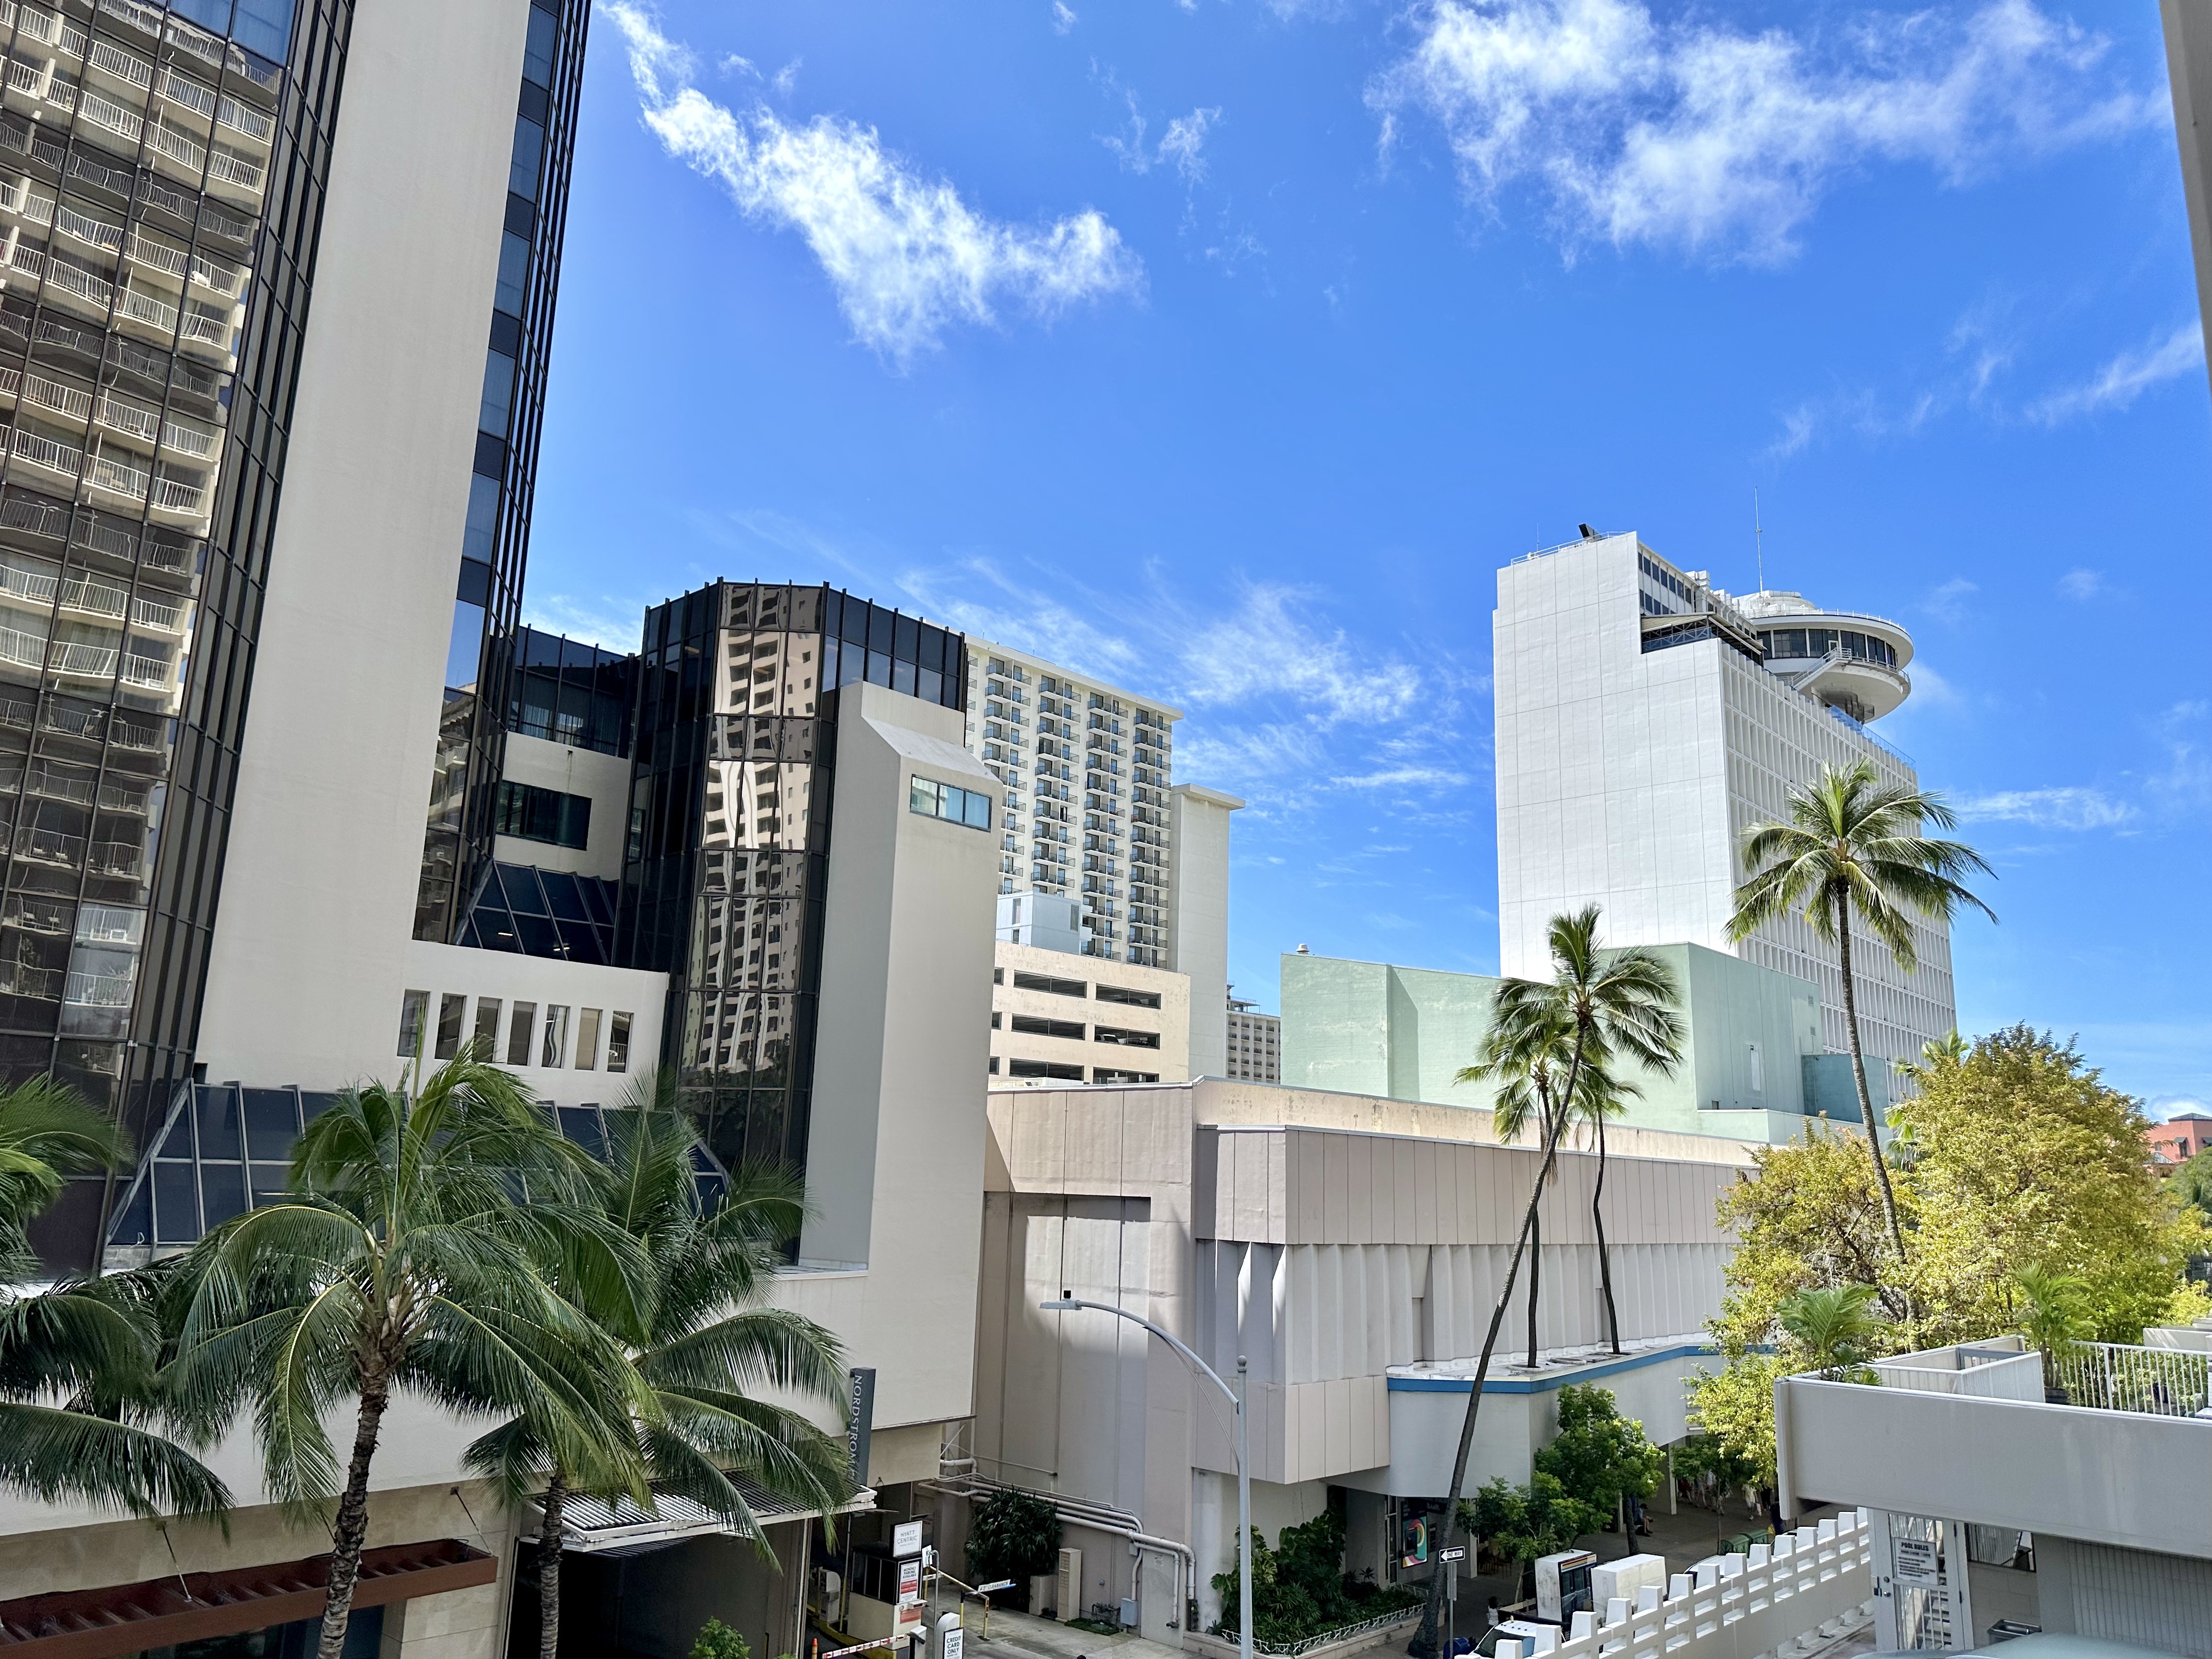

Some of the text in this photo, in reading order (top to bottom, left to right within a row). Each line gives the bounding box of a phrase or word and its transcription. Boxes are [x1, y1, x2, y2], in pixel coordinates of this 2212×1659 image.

[848, 1375, 862, 1464] NORDSTROM
[897, 1535, 918, 1544] CENTRIC
[946, 1635, 961, 1644] CREDIT
